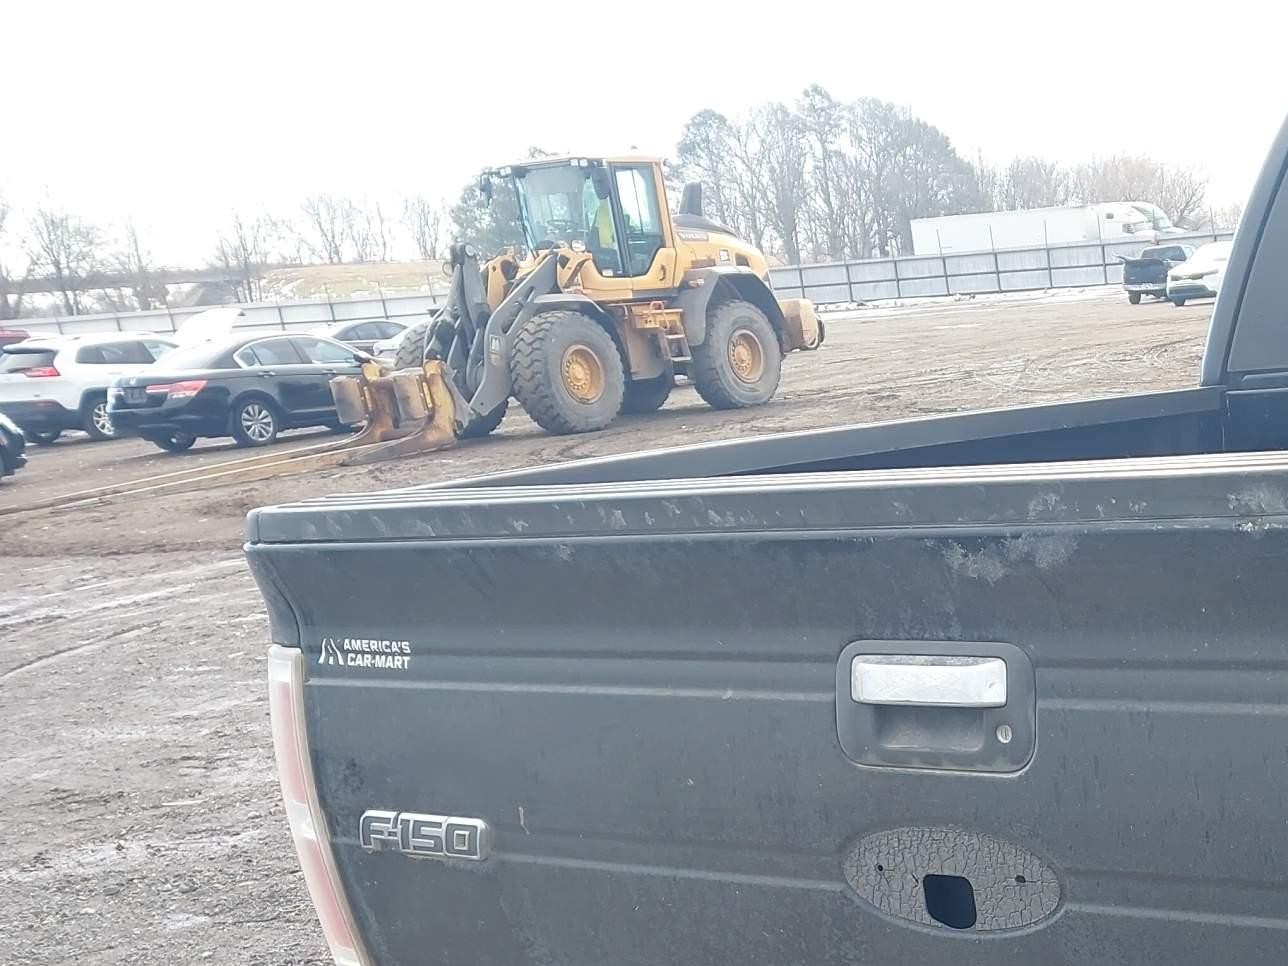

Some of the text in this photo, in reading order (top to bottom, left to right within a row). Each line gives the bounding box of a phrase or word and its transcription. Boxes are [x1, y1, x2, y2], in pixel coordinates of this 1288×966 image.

[343, 638, 411, 653] AMERICA'S
[347, 652, 411, 670] CAR-MART
[360, 809, 488, 861] F-150
